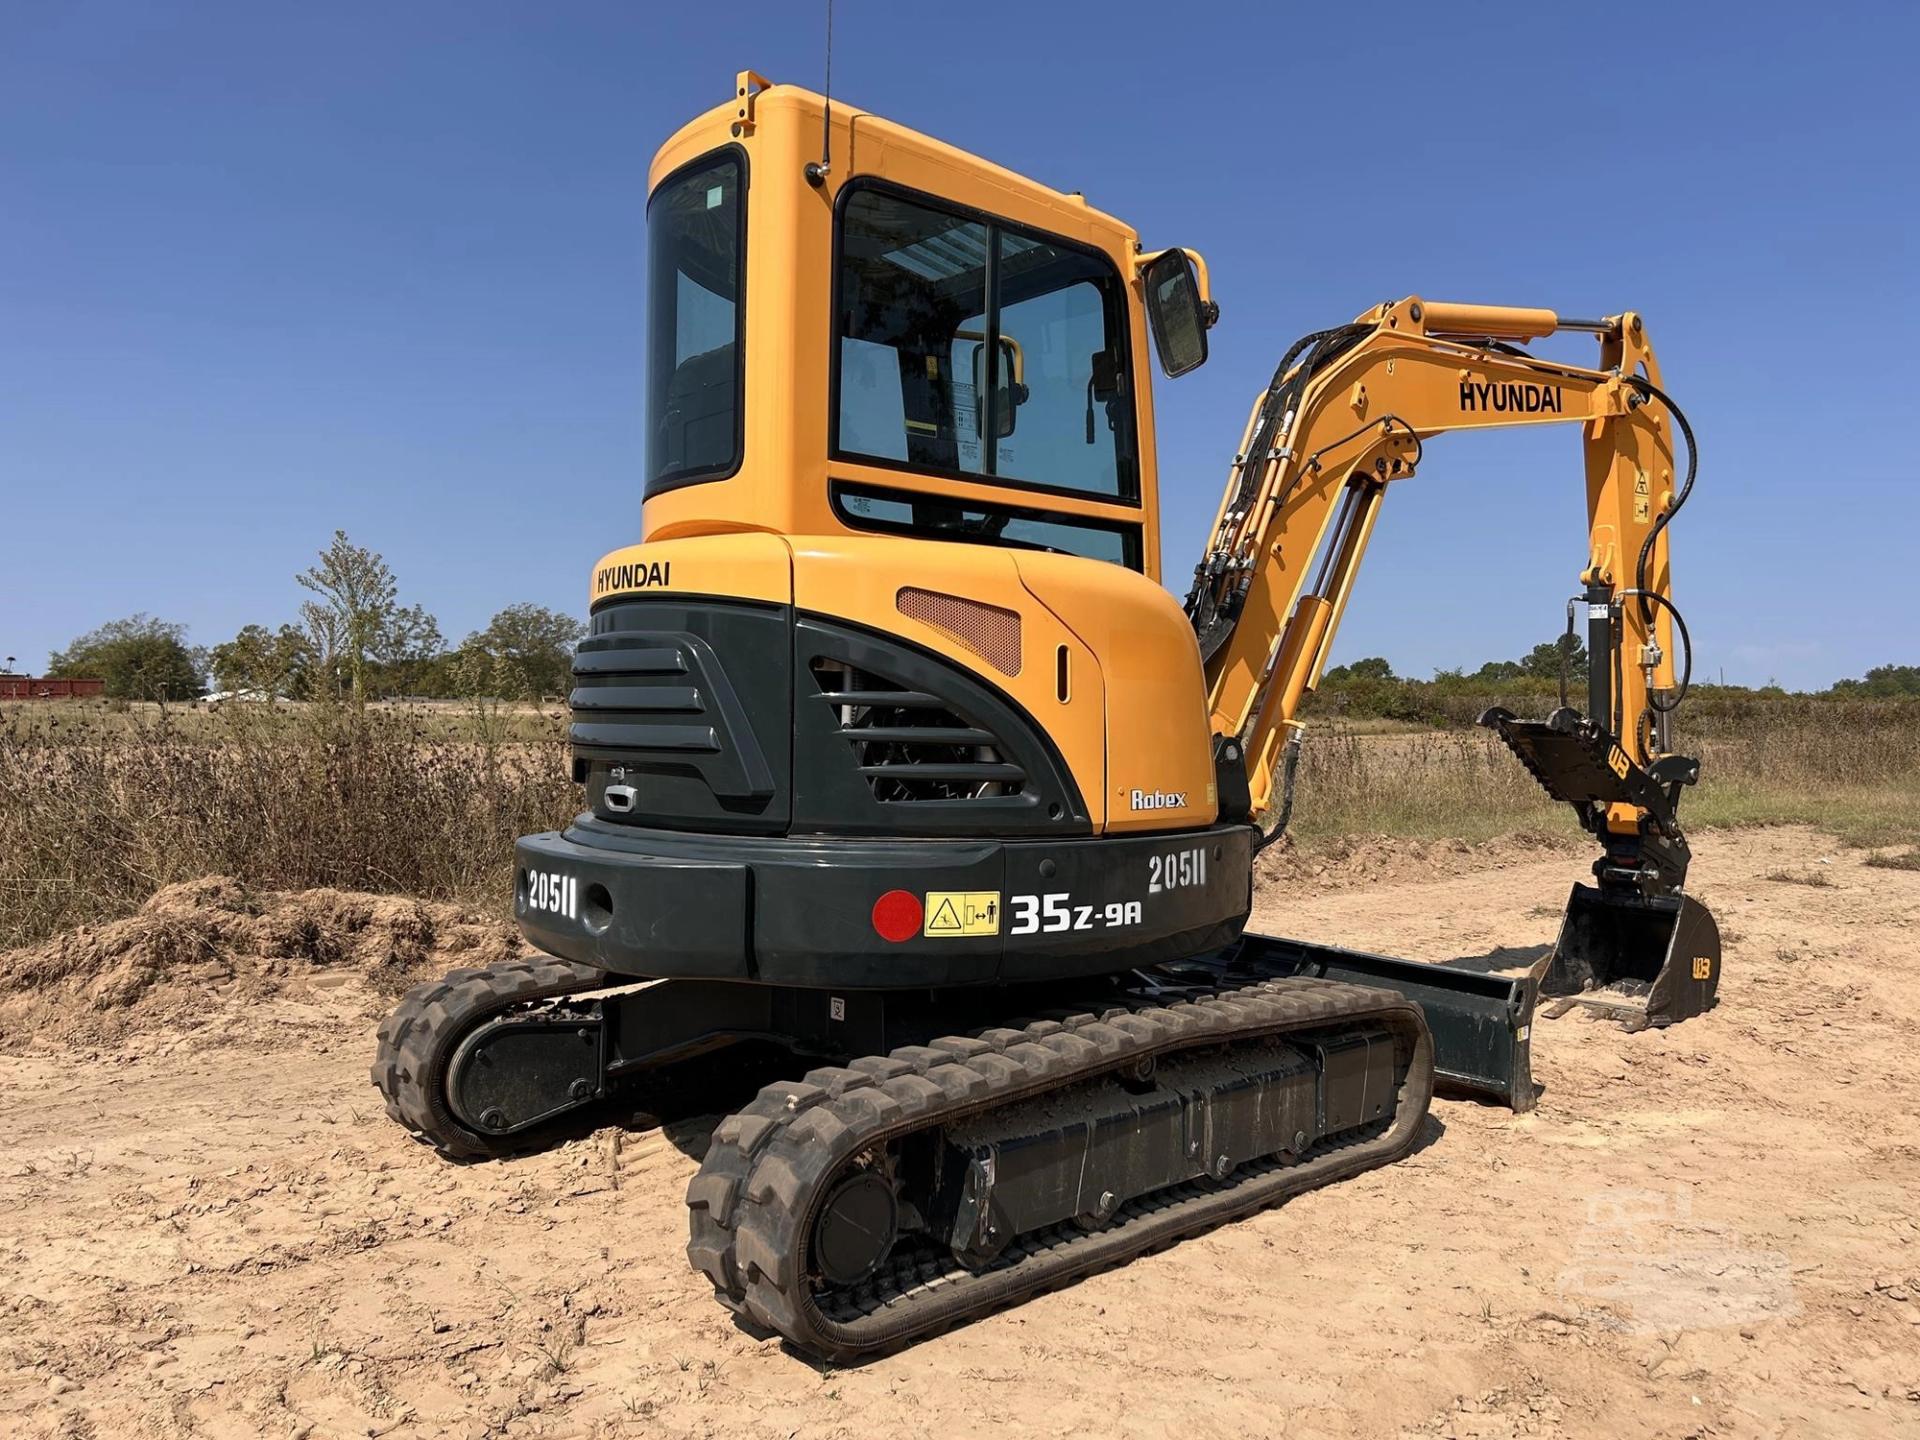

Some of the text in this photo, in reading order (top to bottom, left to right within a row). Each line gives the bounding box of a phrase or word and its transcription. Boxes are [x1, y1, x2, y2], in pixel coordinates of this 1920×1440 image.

[1460, 383, 1561, 412] HYUNDAI
[598, 562, 670, 592] HYUNDAI
[1132, 789, 1187, 811] Robex
[1149, 848, 1206, 893] 20511
[529, 870, 577, 919] 20511
